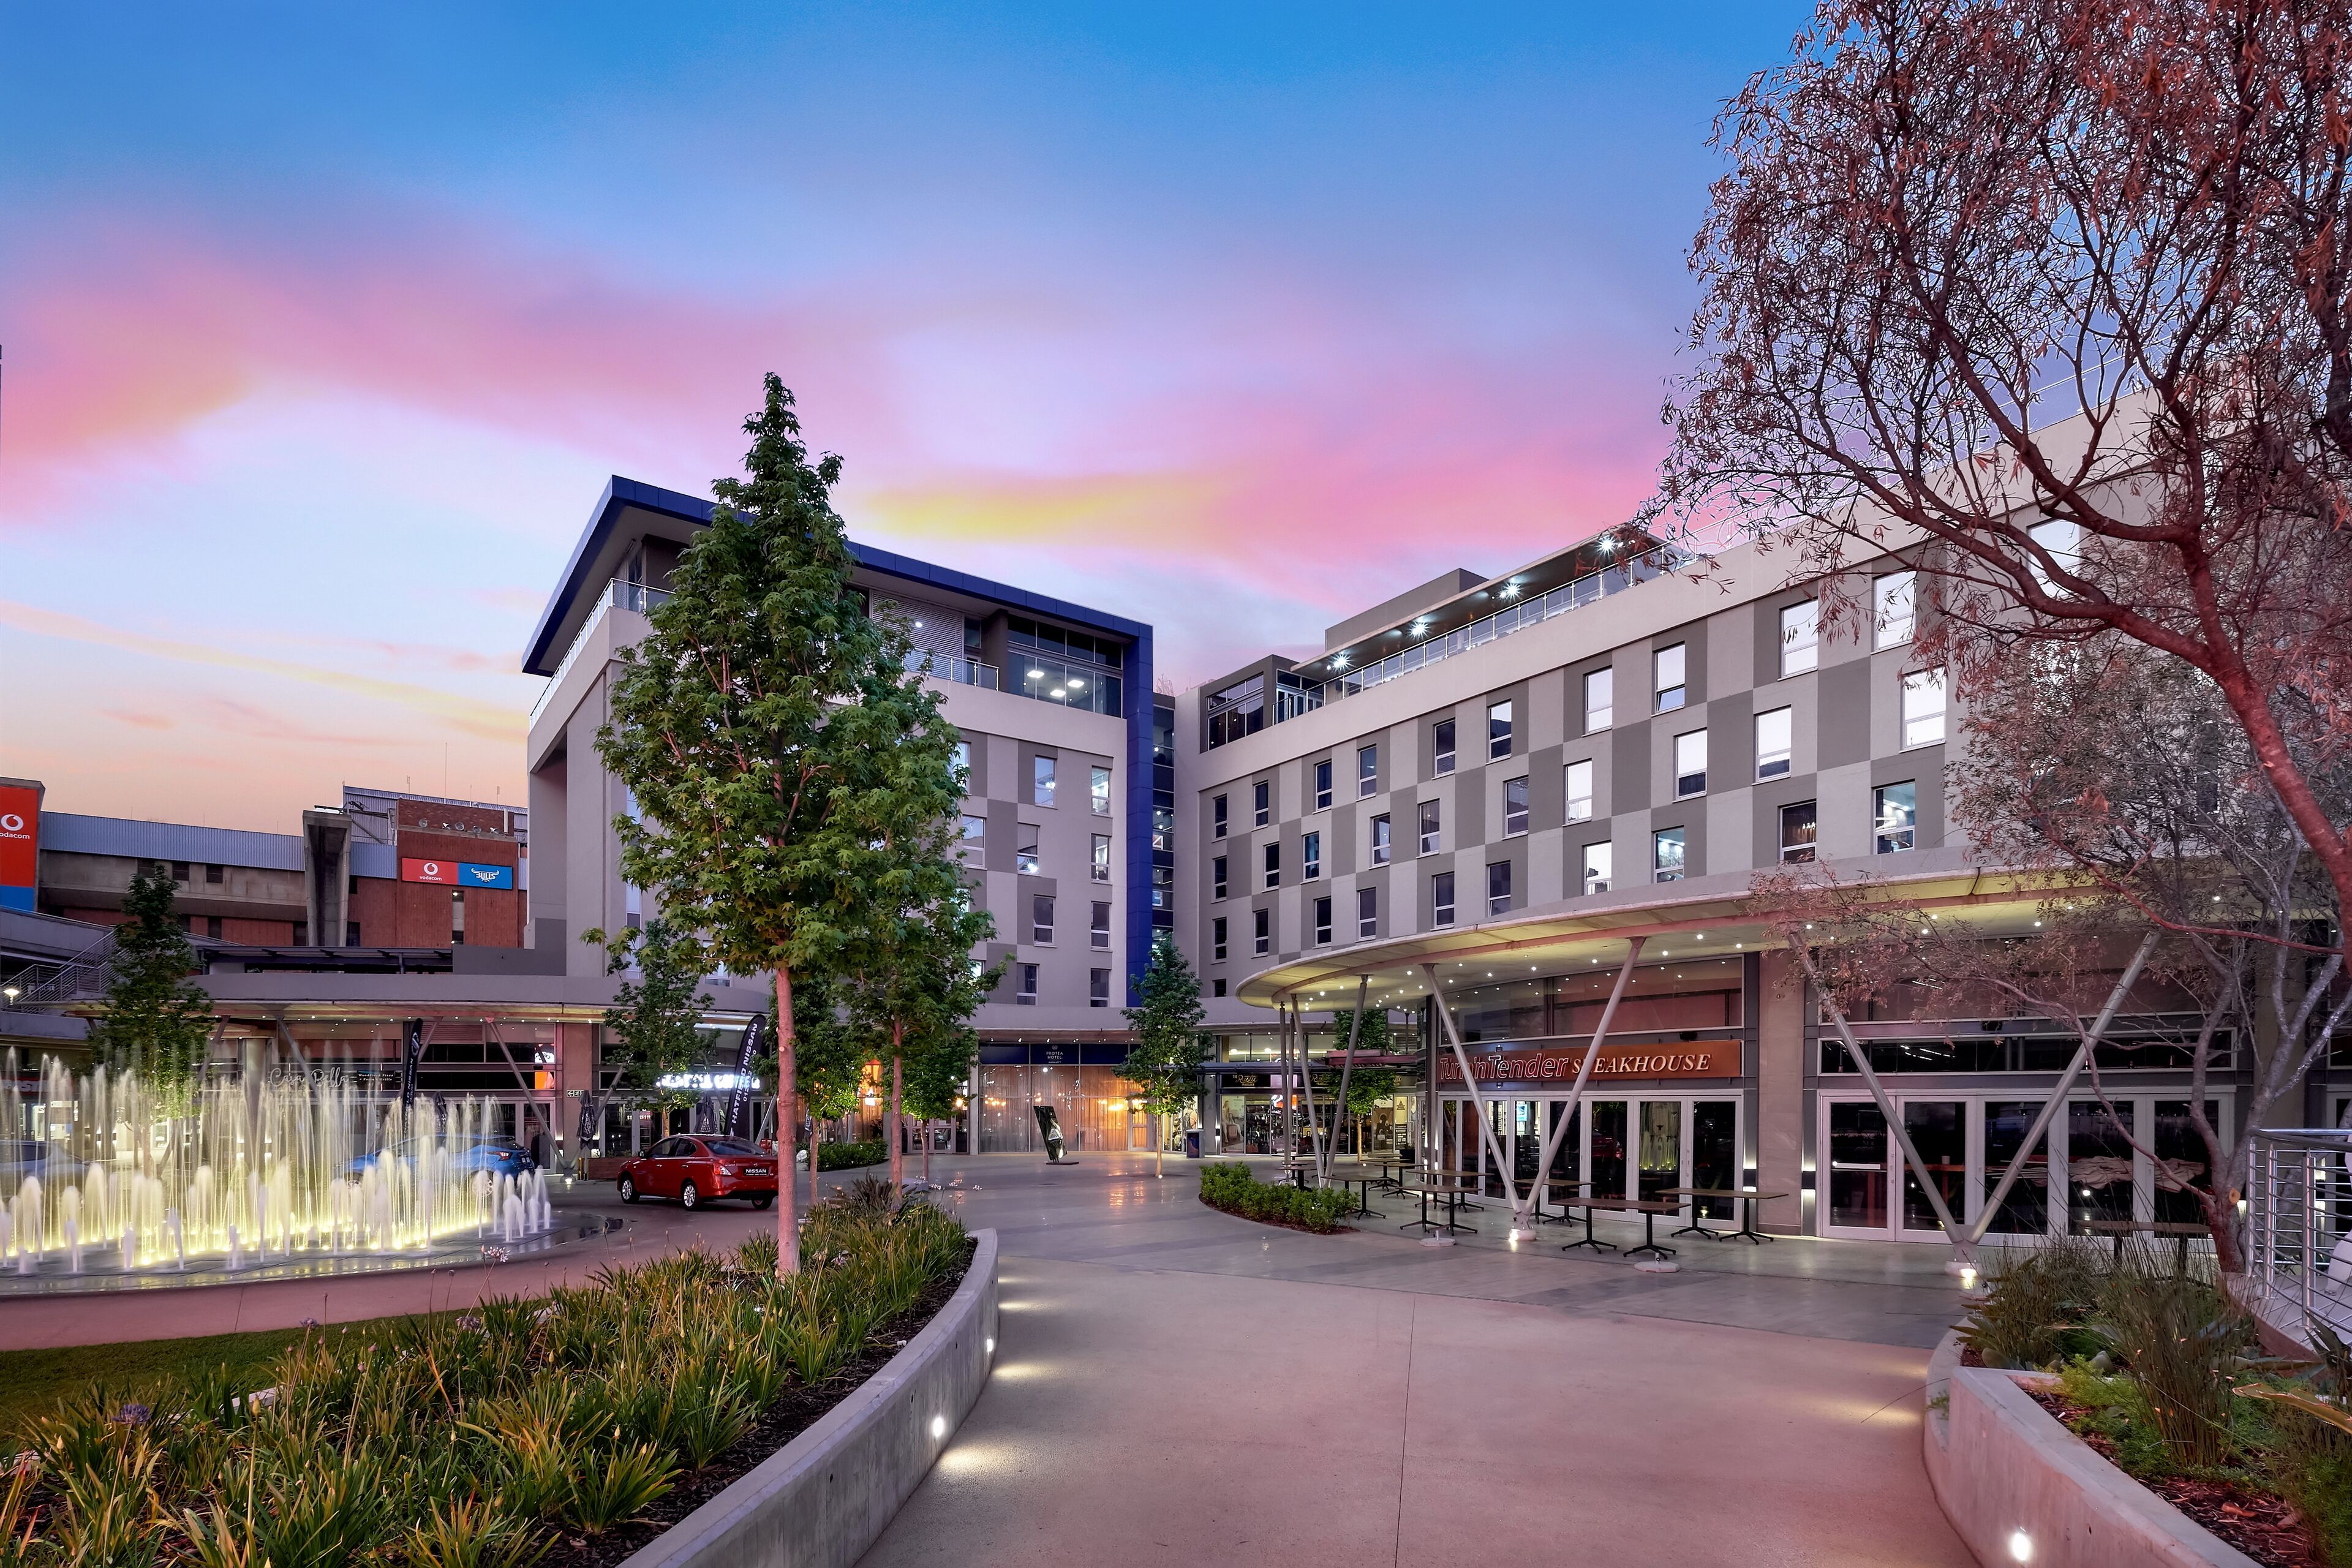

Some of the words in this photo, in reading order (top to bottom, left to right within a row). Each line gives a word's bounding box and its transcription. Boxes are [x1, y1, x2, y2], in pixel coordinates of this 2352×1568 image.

[743, 1023, 758, 1066] NISSAN
[1572, 1054, 1711, 1074] SEAKHOUSE
[270, 1068, 305, 1087] Casa
[311, 1067, 350, 1087] Bella
